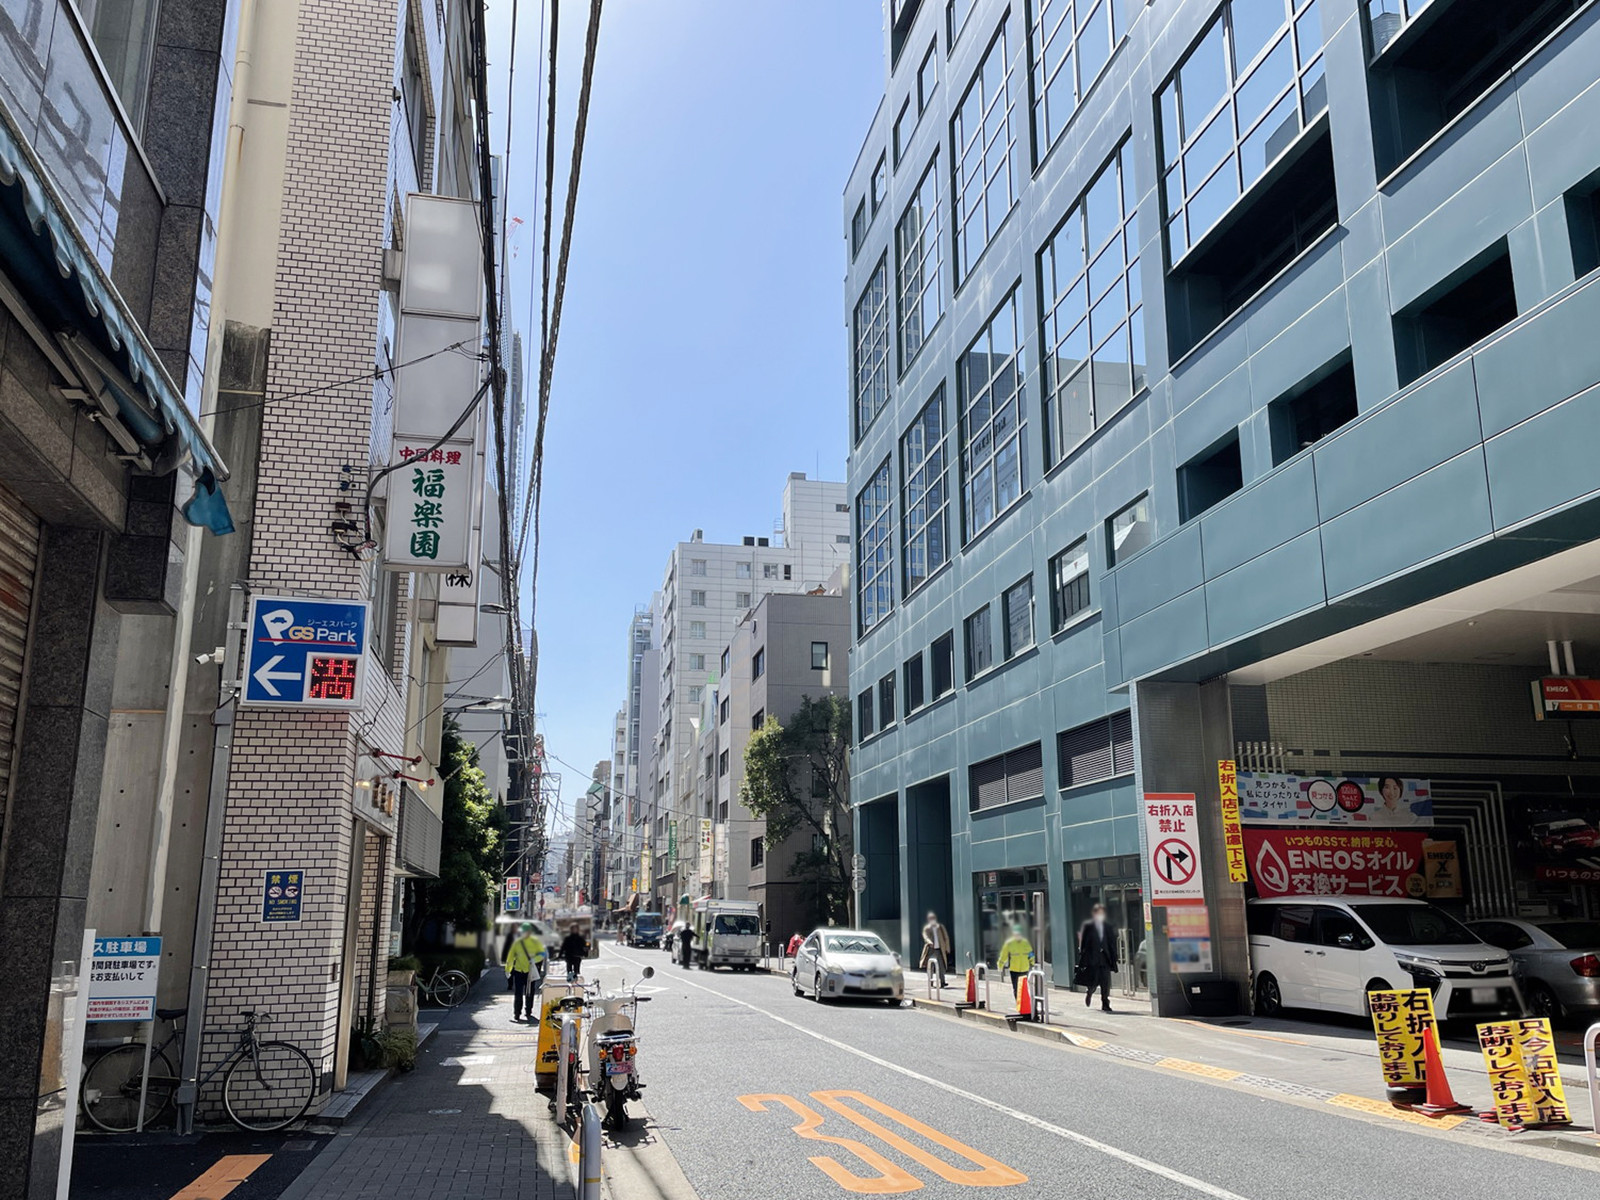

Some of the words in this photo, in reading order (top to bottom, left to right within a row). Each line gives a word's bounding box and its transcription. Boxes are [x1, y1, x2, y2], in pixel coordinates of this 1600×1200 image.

[400, 446, 461, 465] 中国料理
[410, 468, 446, 560] 福楽園
[307, 618, 358, 629] ジーエスパーク
[316, 627, 357, 643] Park
[309, 658, 356, 700] 満
[1546, 685, 1569, 693] ENEOS
[1147, 804, 1194, 817] 右折入店
[1219, 760, 1247, 882] 右折入店ご遠慮下さい
[1158, 818, 1187, 833] 禁止
[1287, 849, 1415, 871] ENEOSオイル
[1291, 871, 1404, 896] 交換サービス
[1370, 992, 1411, 1081] お断りしております
[1479, 1025, 1534, 1125] お断りしております
[1518, 1019, 1569, 1123] 只今右折入店
[736, 1090, 1029, 1194] 30
